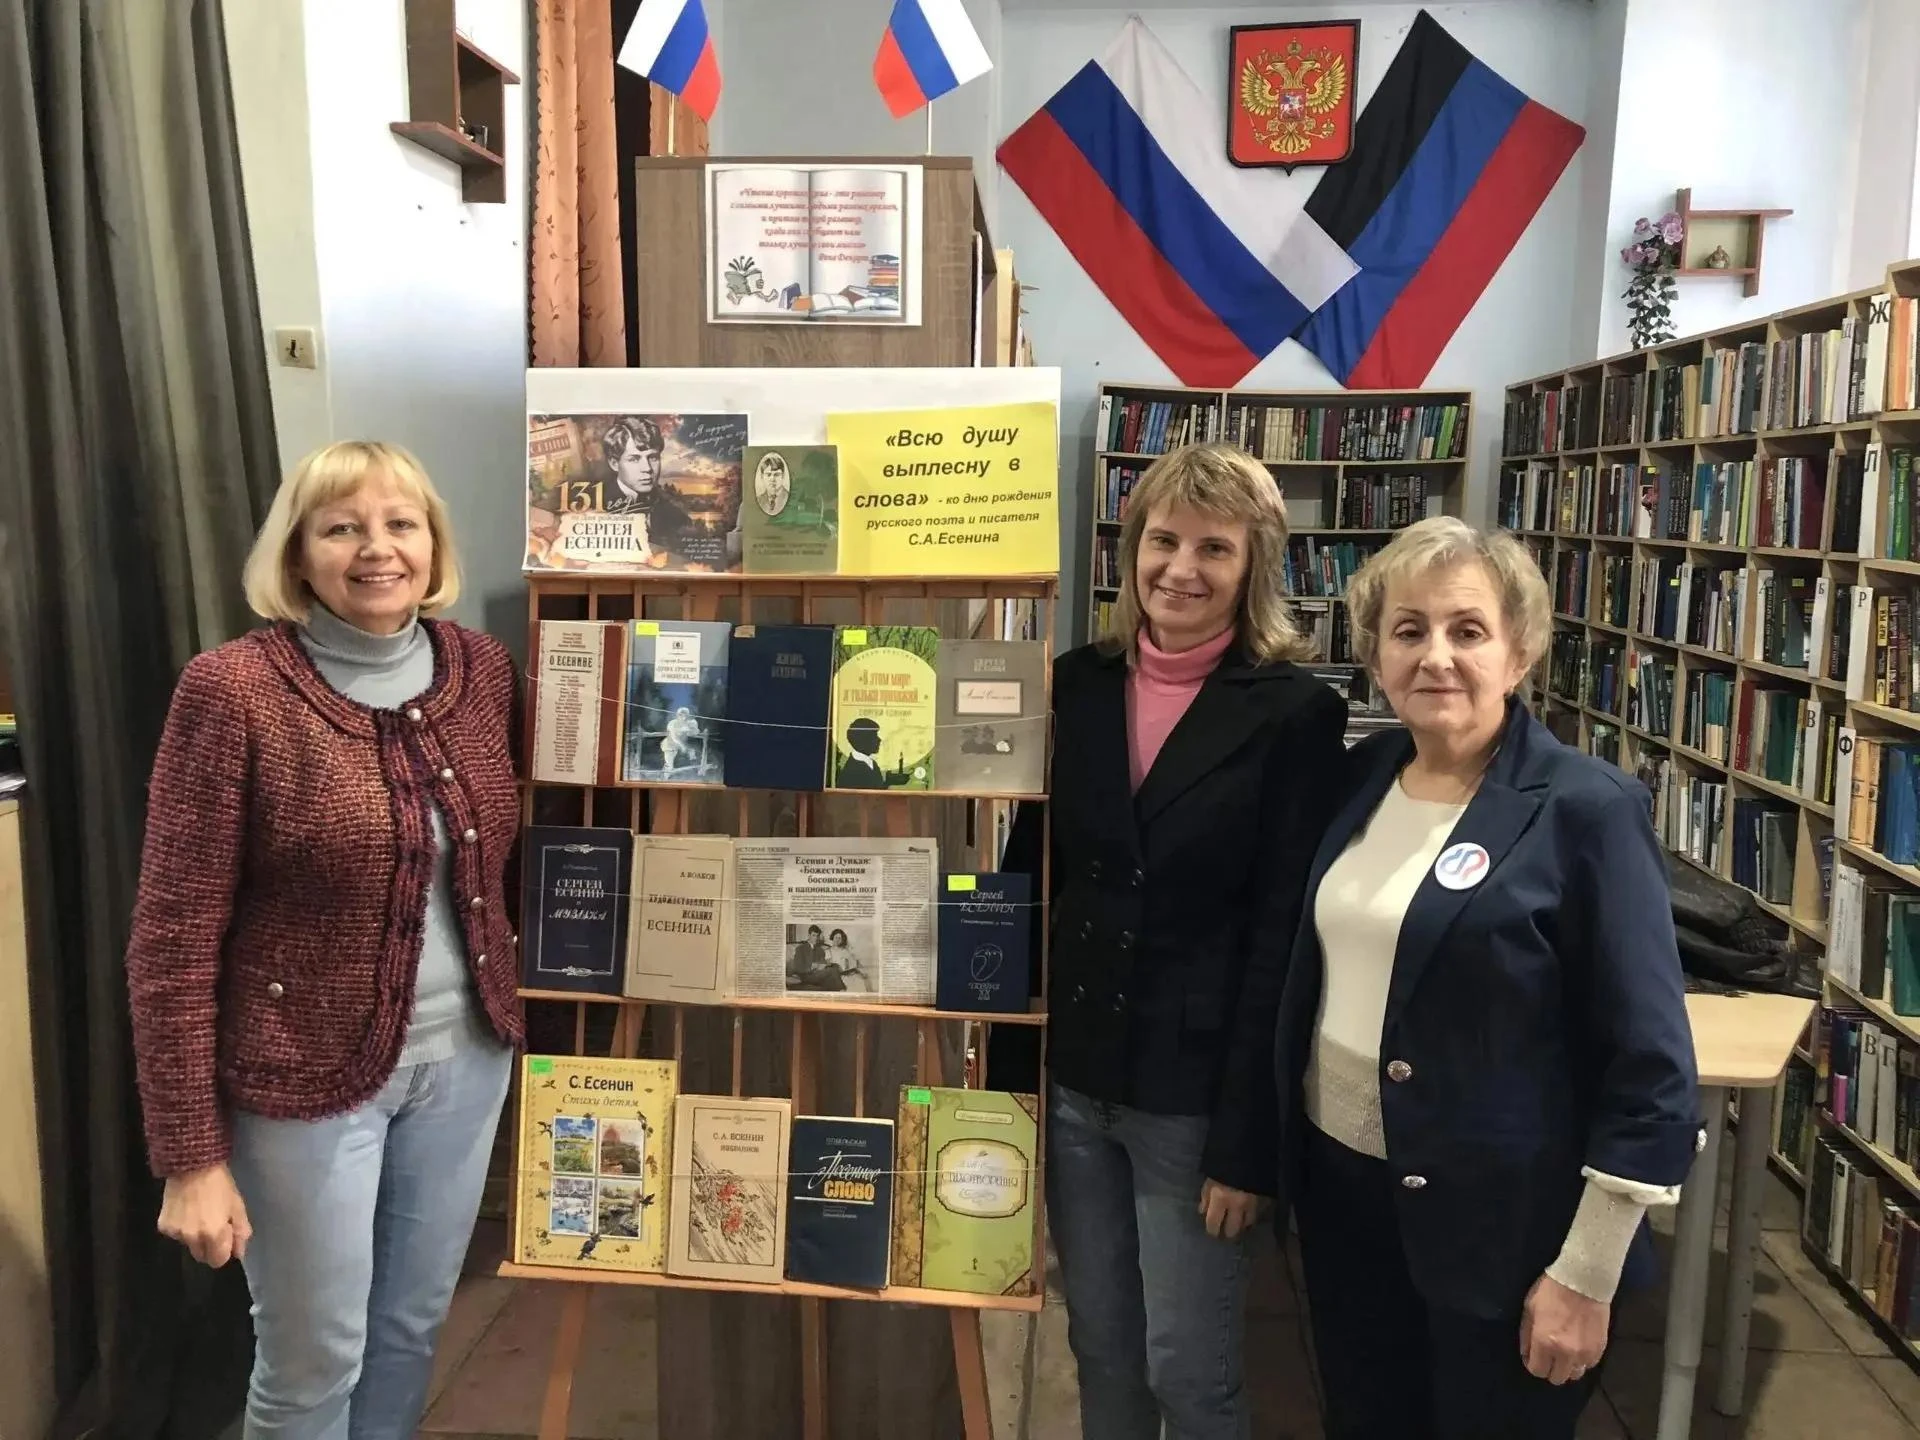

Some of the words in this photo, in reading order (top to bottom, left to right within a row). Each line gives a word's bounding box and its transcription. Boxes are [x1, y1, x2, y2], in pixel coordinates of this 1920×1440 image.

[1869, 300, 1890, 324] Ж
[886, 430, 943, 448] «Всю
[962, 426, 1019, 448] душу
[882, 459, 990, 478] выплесну
[1008, 458, 1021, 471] в
[1864, 450, 1878, 472] Л
[555, 481, 607, 513] 131
[854, 492, 929, 509] слова»
[946, 495, 960, 505] ко
[963, 491, 989, 504] дню
[992, 489, 1052, 504] рождения
[866, 518, 923, 530] русского
[925, 516, 965, 526] поэта
[968, 515, 976, 525] и
[979, 511, 1040, 524] писателя
[572, 522, 632, 536] СЕРГЕЯ
[565, 536, 643, 552] ЕСЕНИНА
[908, 532, 1000, 546] С.А.Есенина
[1858, 591, 1867, 608] Р
[549, 655, 555, 666] О
[557, 655, 593, 668] ЕСЕНИНЕ
[1839, 735, 1853, 756] Ф
[795, 856, 827, 865] Есенин
[687, 871, 716, 880] ВОЛКОВ
[799, 866, 867, 875] «Божественная
[556, 878, 602, 889] СЕРГЕЙ
[795, 885, 857, 893] национальный
[555, 887, 604, 898] ЕСЕНИН
[970, 889, 1004, 902] Сергей
[682, 910, 713, 921] ИСКАНИЯ
[647, 919, 711, 936] ЕСЕНИНА
[1864, 1033, 1877, 1056] В
[569, 1075, 582, 1089] С.
[584, 1075, 634, 1092] Есенин
[562, 1093, 600, 1105] Стихи
[603, 1096, 640, 1108] детям
[712, 1132, 720, 1140] С.
[730, 1132, 765, 1142] ЕСЕНИН
